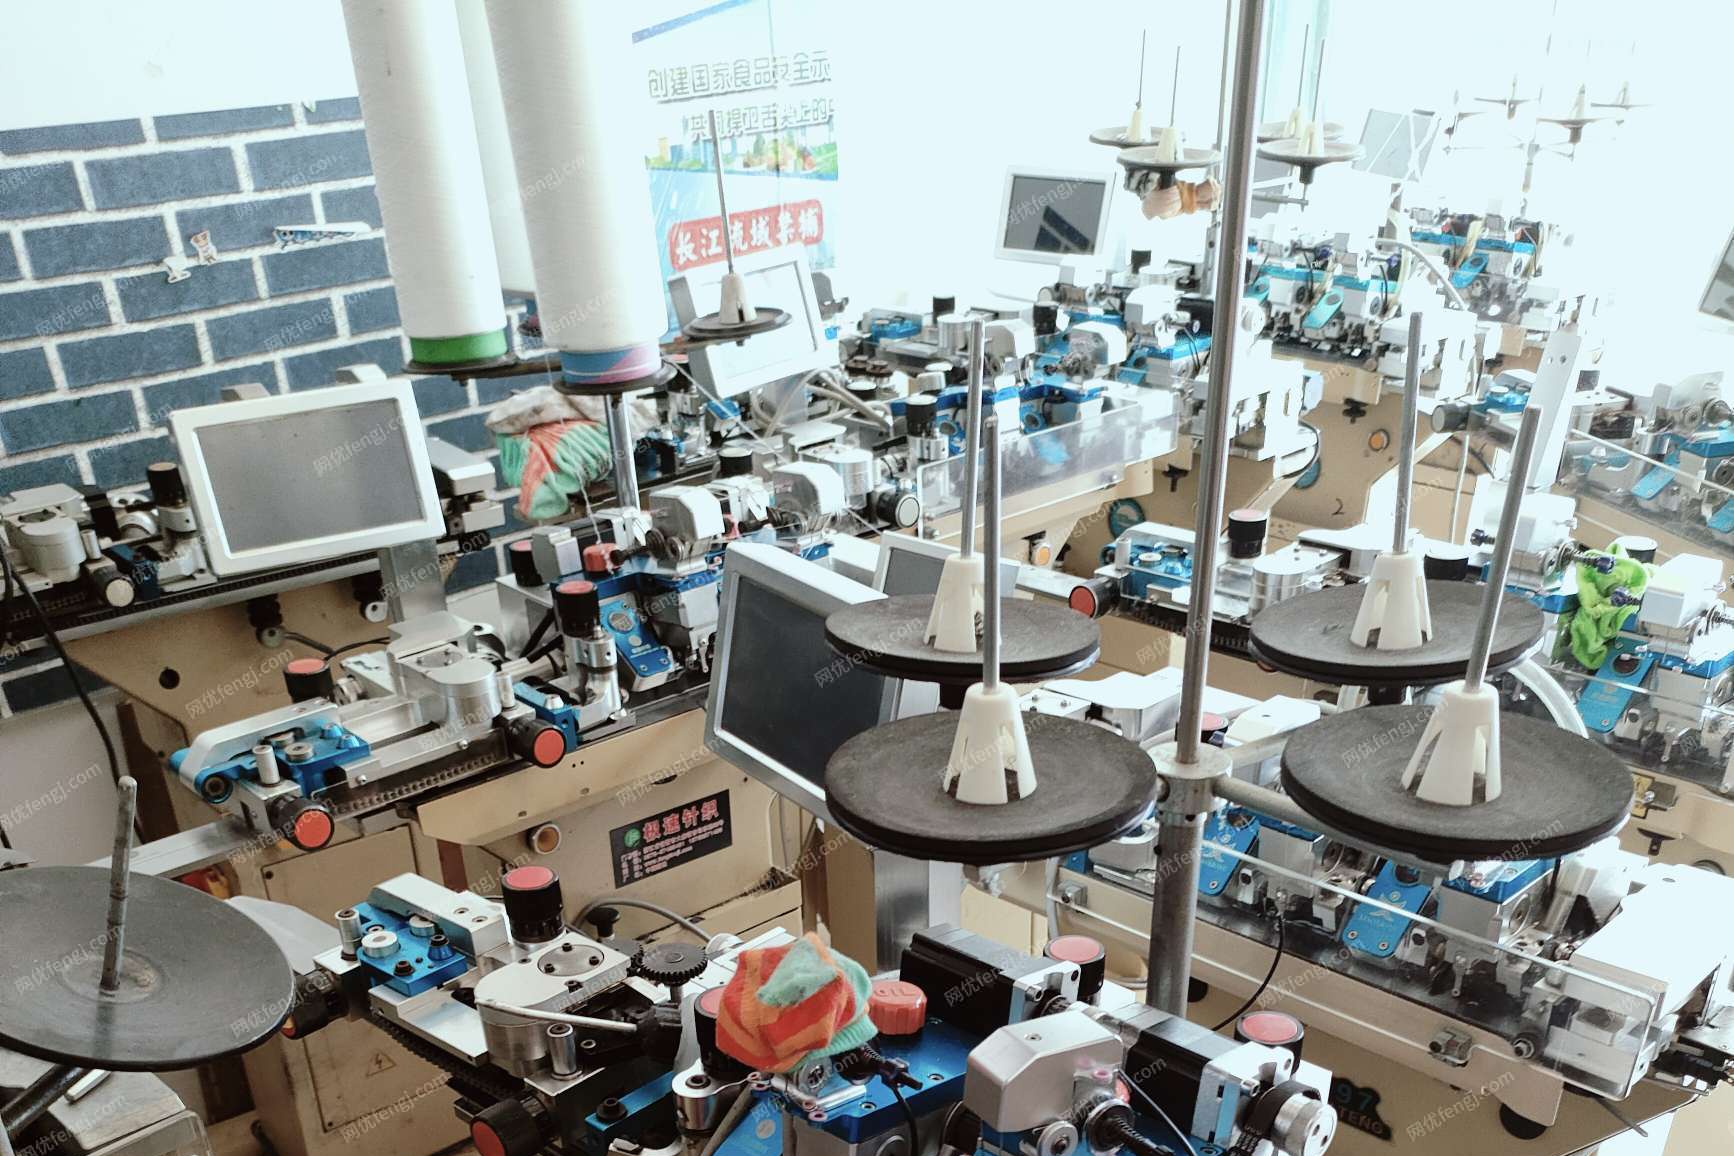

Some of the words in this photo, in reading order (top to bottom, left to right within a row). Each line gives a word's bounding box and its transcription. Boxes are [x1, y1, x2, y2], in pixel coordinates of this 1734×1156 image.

[691, 98, 834, 143] 共同捍卫舌尖上的
[676, 207, 819, 265] 长江流域禁捕
[1331, 497, 1345, 516] 2
